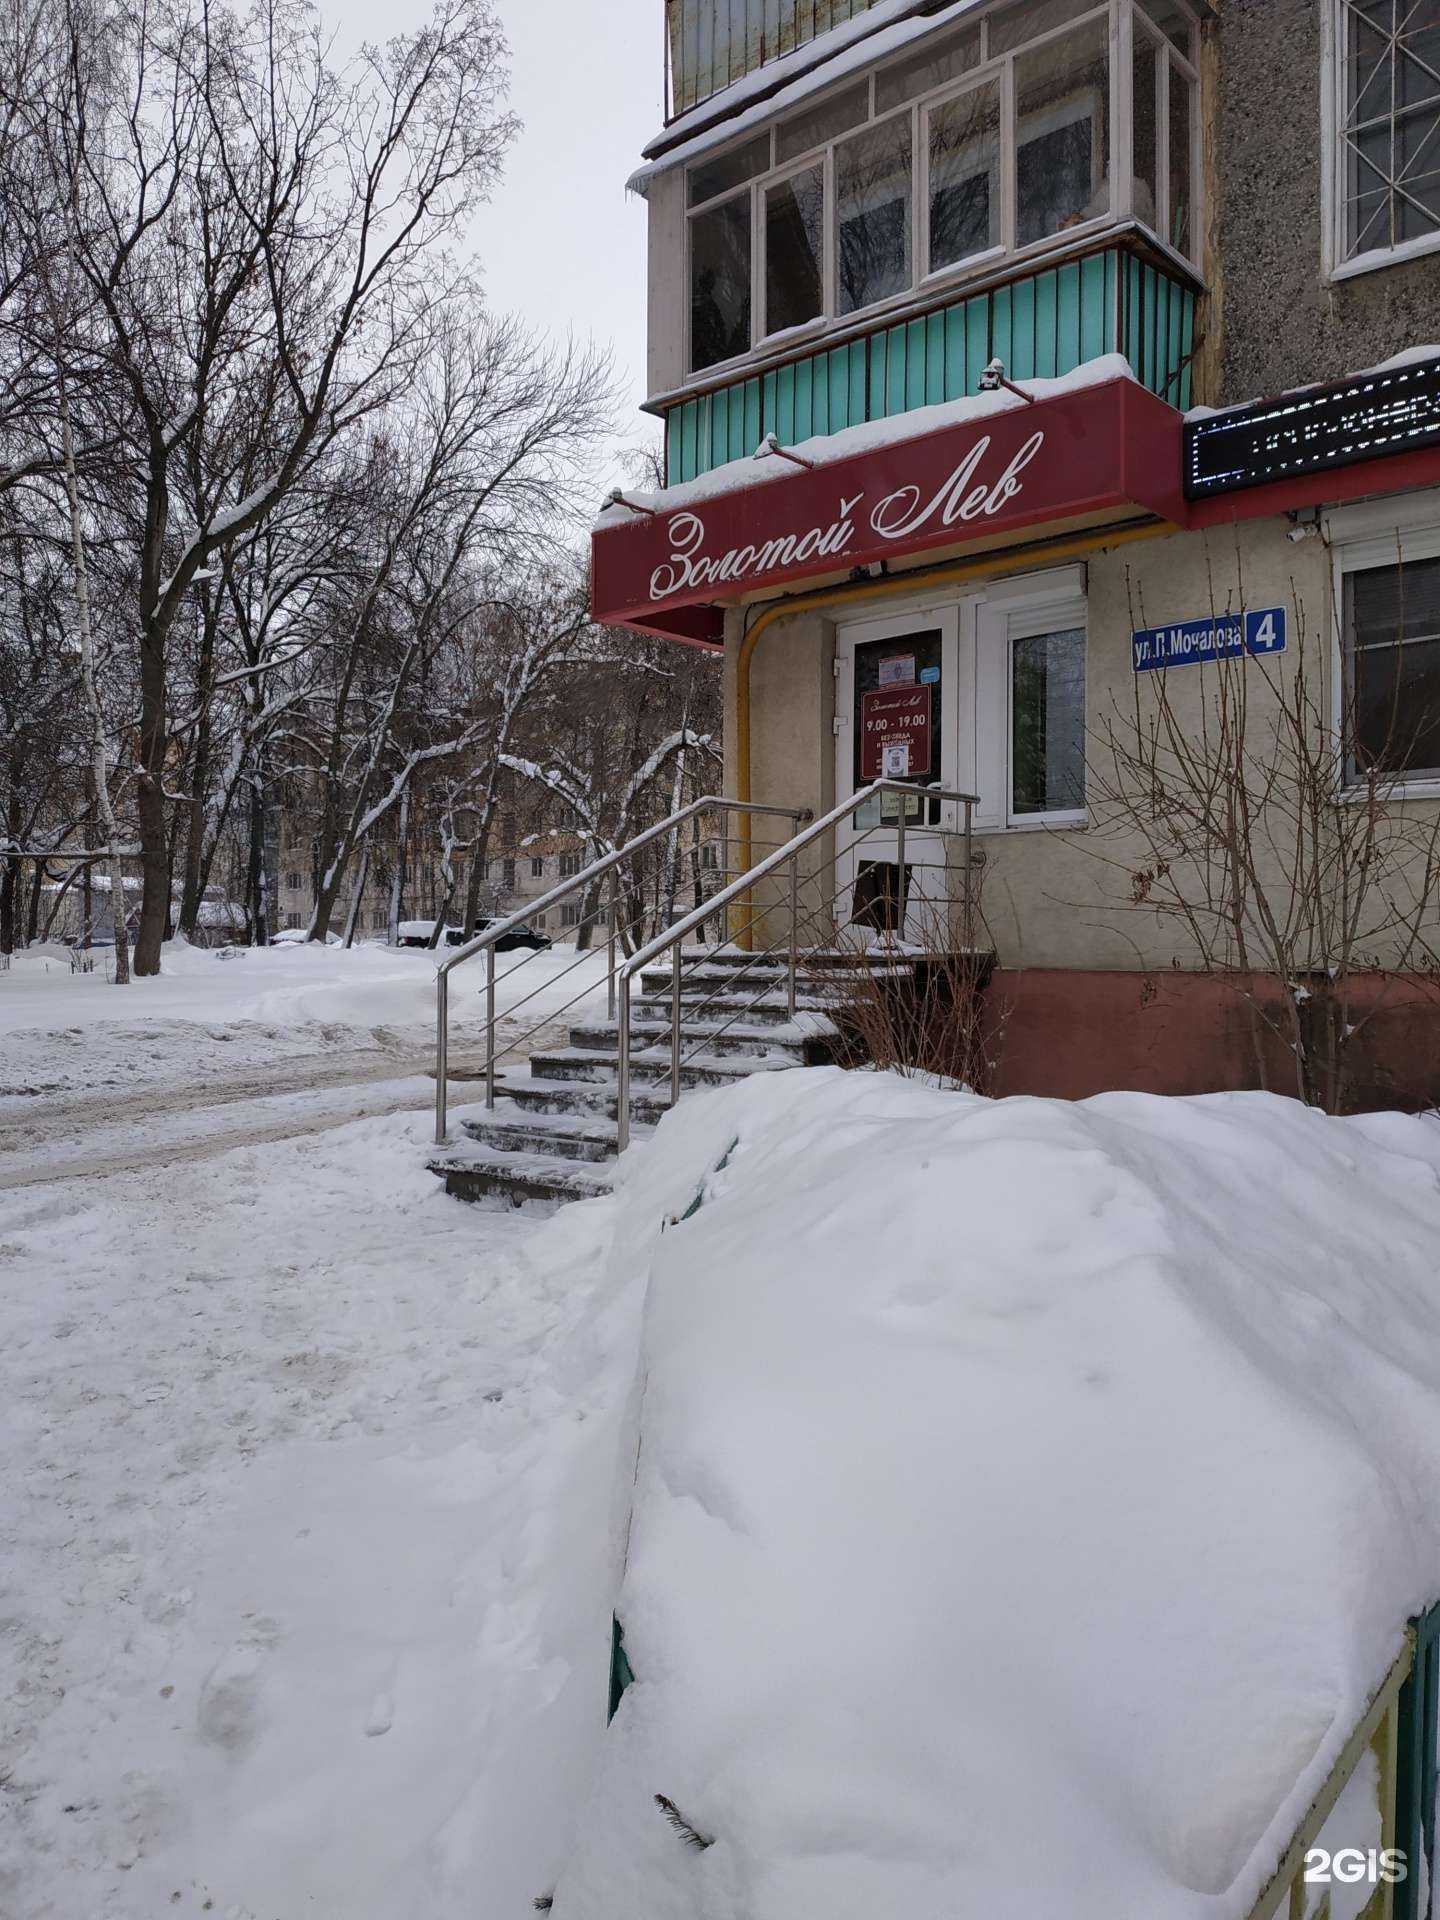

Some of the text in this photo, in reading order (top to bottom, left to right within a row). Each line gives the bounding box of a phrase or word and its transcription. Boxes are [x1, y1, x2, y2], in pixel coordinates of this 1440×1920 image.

[649, 431, 1044, 600] Золотой Лев
[1255, 613, 1276, 648] 4
[866, 719, 887, 731] 9.00
[898, 714, 926, 727] 19.00
